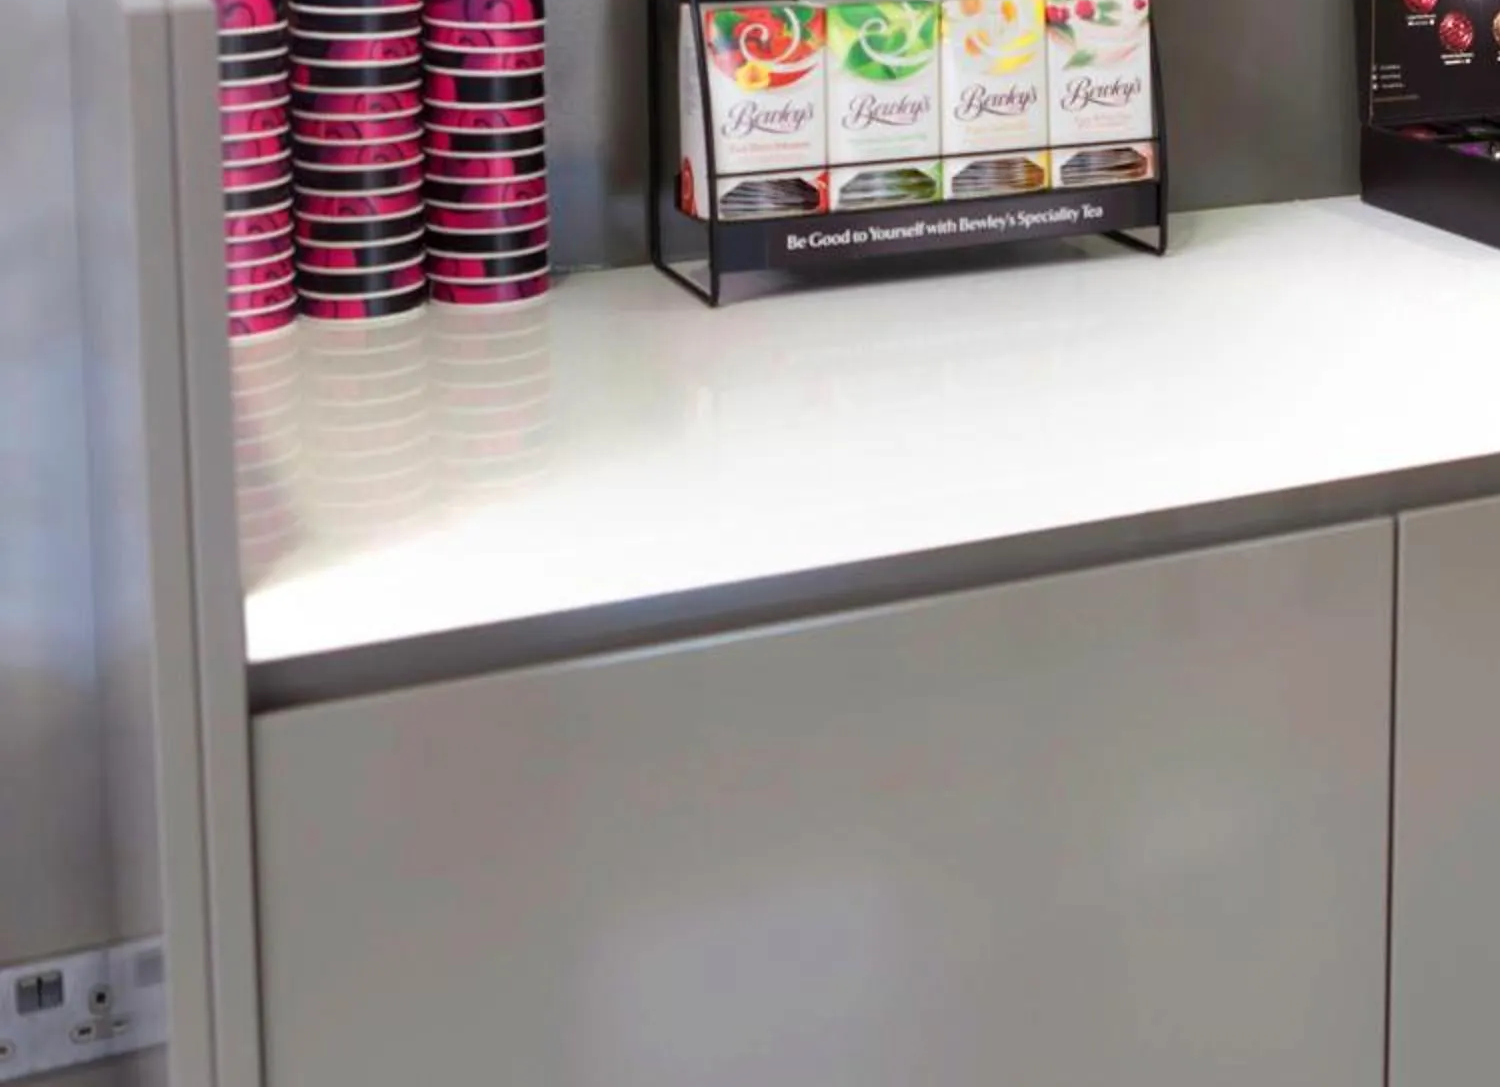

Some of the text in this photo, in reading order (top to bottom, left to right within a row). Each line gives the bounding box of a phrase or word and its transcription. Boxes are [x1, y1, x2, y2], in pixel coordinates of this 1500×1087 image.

[841, 93, 931, 130] Bewley's
[953, 83, 1038, 122] Bewley's
[1060, 75, 1142, 112] Bewley's
[720, 99, 815, 139] Bewley's
[786, 202, 1104, 250] Be Good to Yourself with Bewley's Speciality Tea
